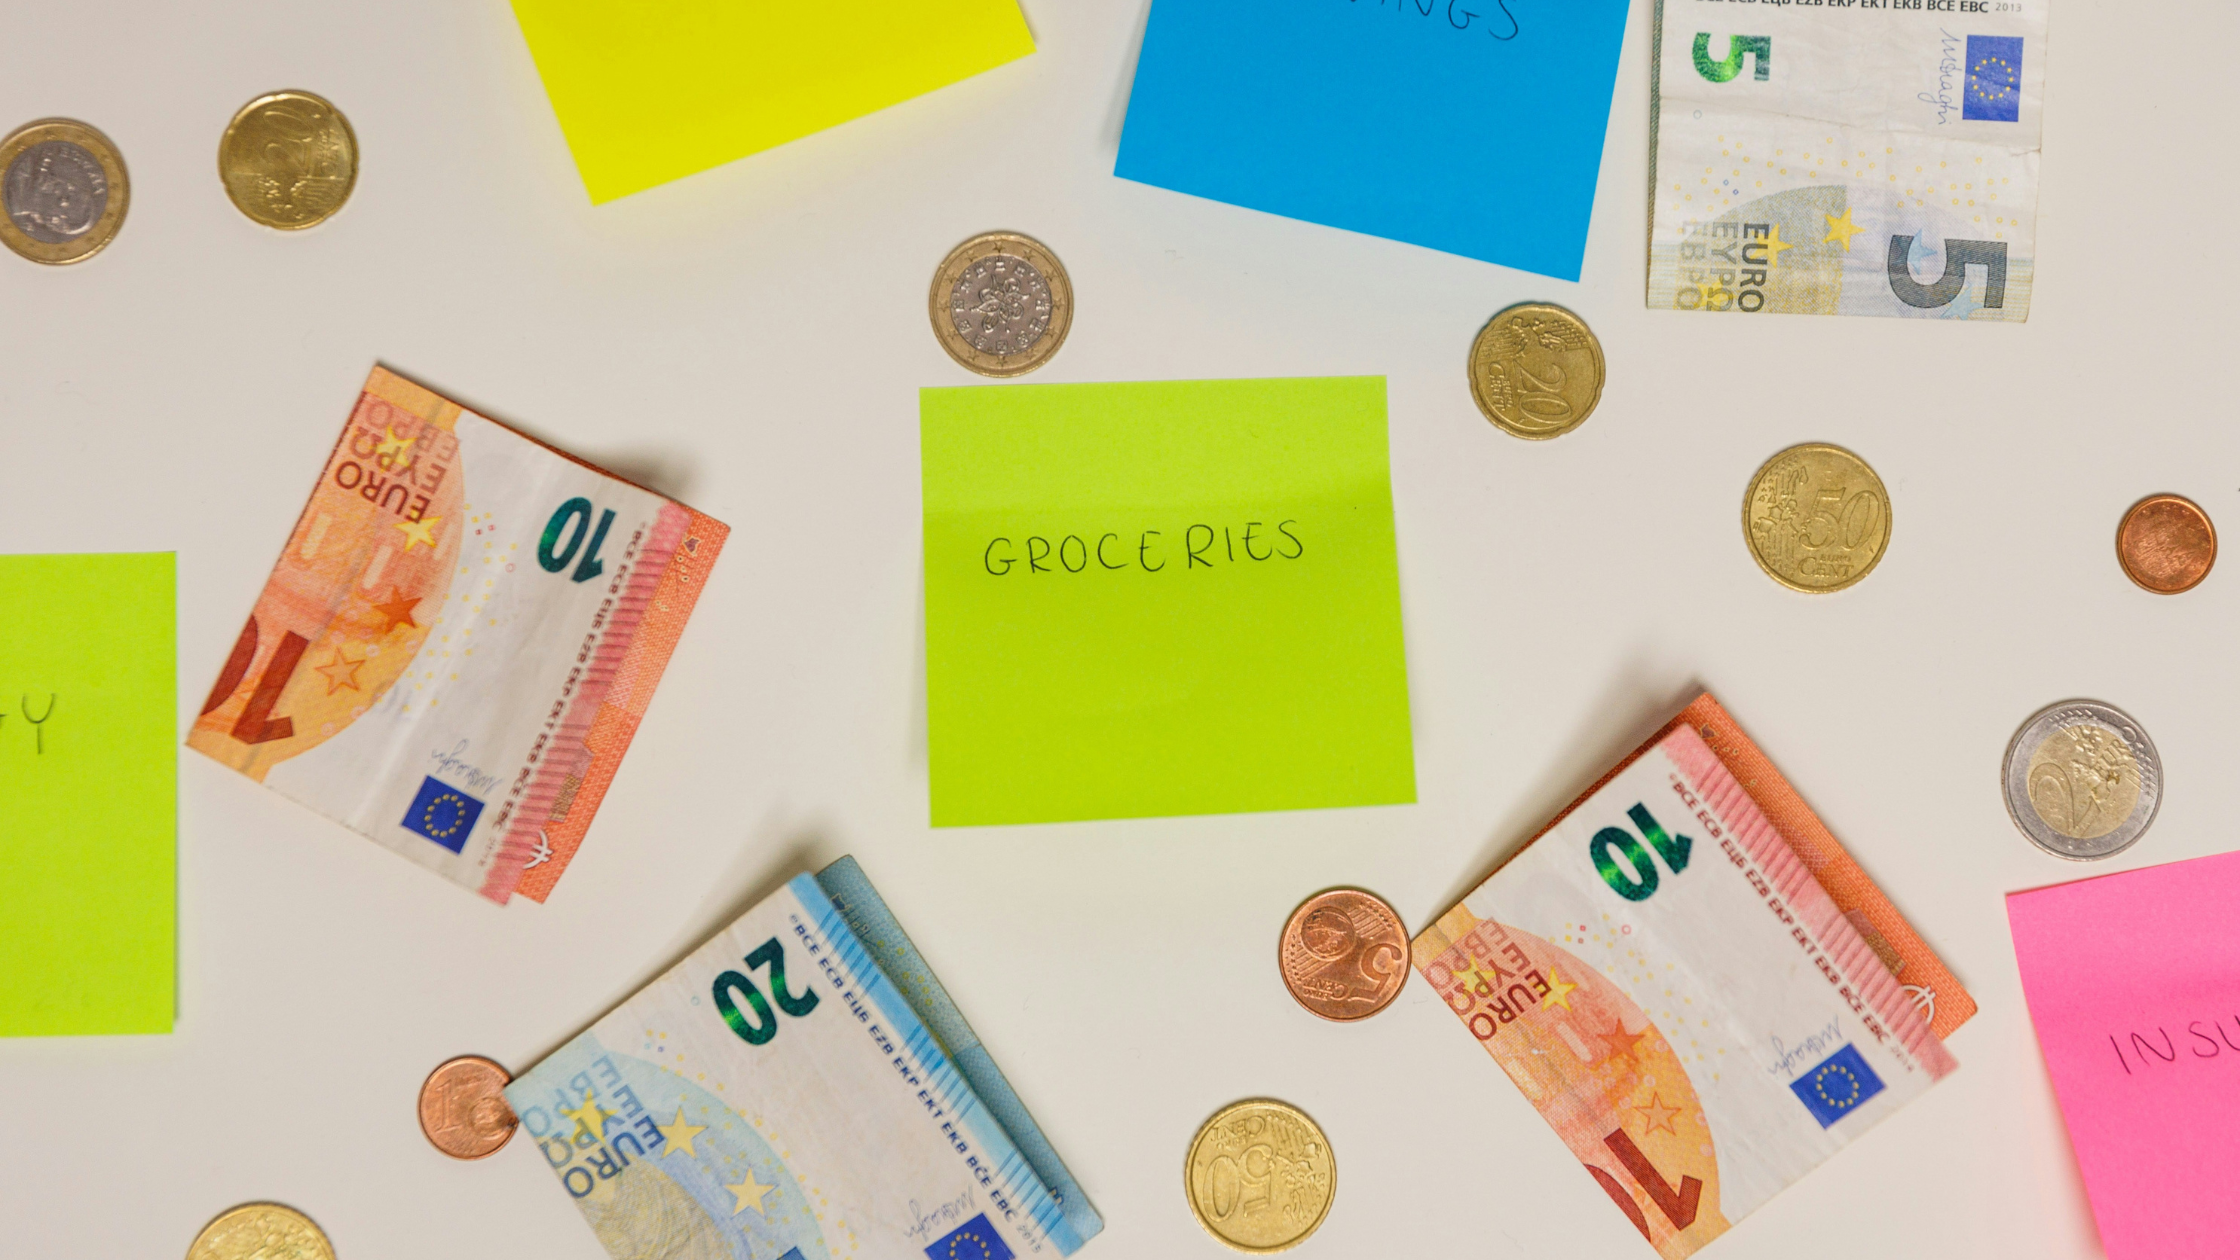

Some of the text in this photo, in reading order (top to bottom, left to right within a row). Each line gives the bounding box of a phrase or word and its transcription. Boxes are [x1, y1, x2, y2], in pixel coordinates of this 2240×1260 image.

[1893, 0, 1922, 10] EKB
[1960, 1, 1989, 13] EBC
[1995, 2, 2022, 12] 2013
[1691, 32, 1771, 84] 5
[1737, 222, 1769, 313] EURO
[1888, 234, 2008, 309] 5
[1514, 359, 1572, 424] 20
[335, 460, 430, 524] EURO
[1799, 486, 1880, 550] 50
[536, 496, 616, 584] 10
[984, 519, 1304, 576] GROCERIES
[1798, 556, 1854, 578] CENT
[0, 692, 57, 755] Y
[2029, 761, 2102, 838] 2
[1589, 801, 1694, 902] 10
[1697, 810, 1722, 837] ECB
[1745, 869, 1770, 896] EZB
[1769, 898, 1794, 926] EKP
[1792, 926, 1817, 954] EKT
[1816, 956, 1841, 984] EKB
[1864, 1014, 1889, 1043] EBC
[712, 936, 820, 1046] 20
[1347, 943, 1403, 1003] 5
[1468, 969, 1552, 1041] EURO
[819, 957, 844, 987] ECB
[869, 1025, 893, 1054] EZB
[893, 1058, 917, 1087] EKP
[917, 1090, 941, 1118] EKT
[941, 1123, 966, 1153] EKB
[990, 1190, 1016, 1221] EBC
[562, 1115, 666, 1199] EURO
[1203, 1144, 1274, 1223] 50
